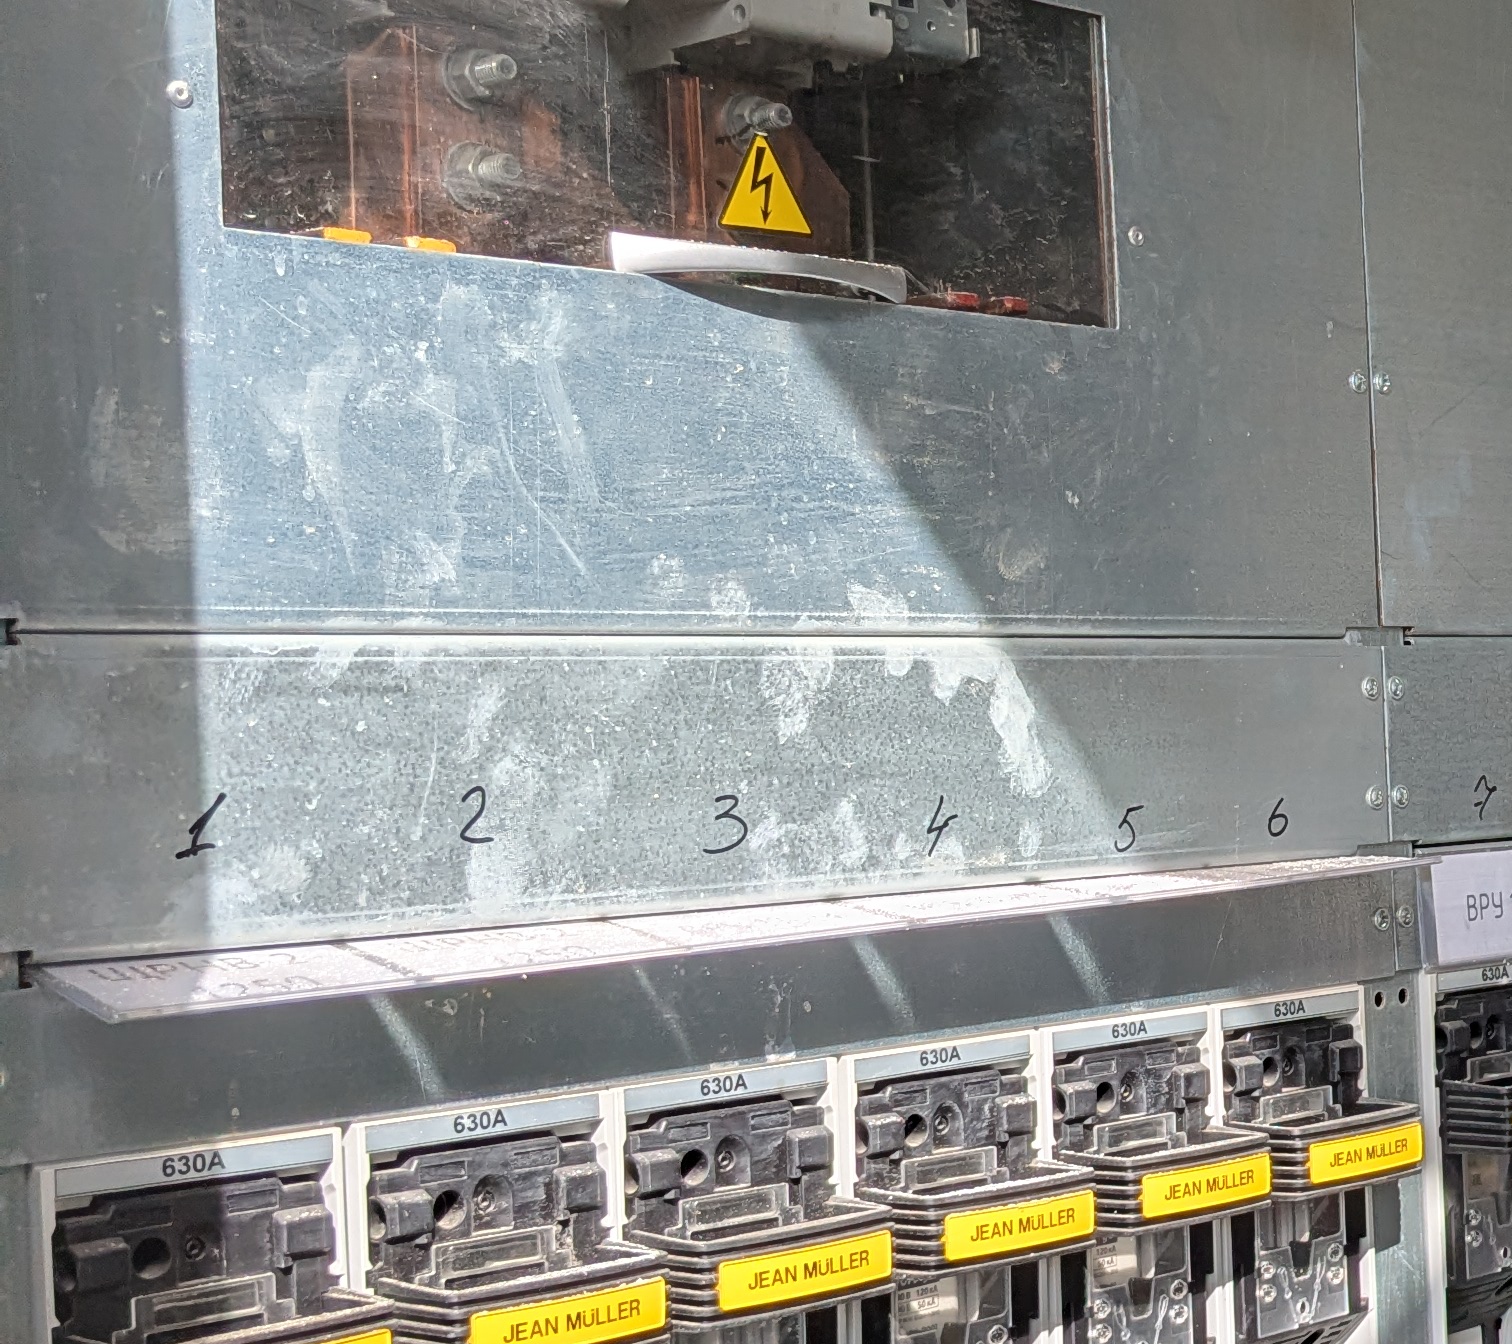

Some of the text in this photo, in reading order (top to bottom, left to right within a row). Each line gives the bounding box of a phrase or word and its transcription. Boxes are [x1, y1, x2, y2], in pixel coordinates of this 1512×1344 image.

[460, 785, 495, 843] 2
[1474, 775, 1497, 820] 7
[175, 792, 227, 859] 1
[703, 794, 749, 854] 3
[926, 794, 959, 857] 4
[1114, 805, 1146, 853] 5
[1267, 798, 1289, 838] 6
[1466, 891, 1503, 922] ВРУ
[1482, 965, 1509, 981] 630A
[1273, 999, 1306, 1018] 630A
[1111, 1020, 1148, 1039] 630A
[919, 1044, 962, 1067] 630A
[699, 1073, 748, 1097] 630A
[453, 1110, 508, 1134] 630A
[161, 1151, 226, 1178] 630A
[1329, 1149, 1363, 1167] JEAN
[1164, 1168, 1255, 1201] JEAN MÜLLER
[970, 1207, 1076, 1243] JEAN MÜLLER
[747, 1249, 870, 1292] JEAN MÜLLER
[502, 1298, 642, 1344] JEAN MÜLLER
